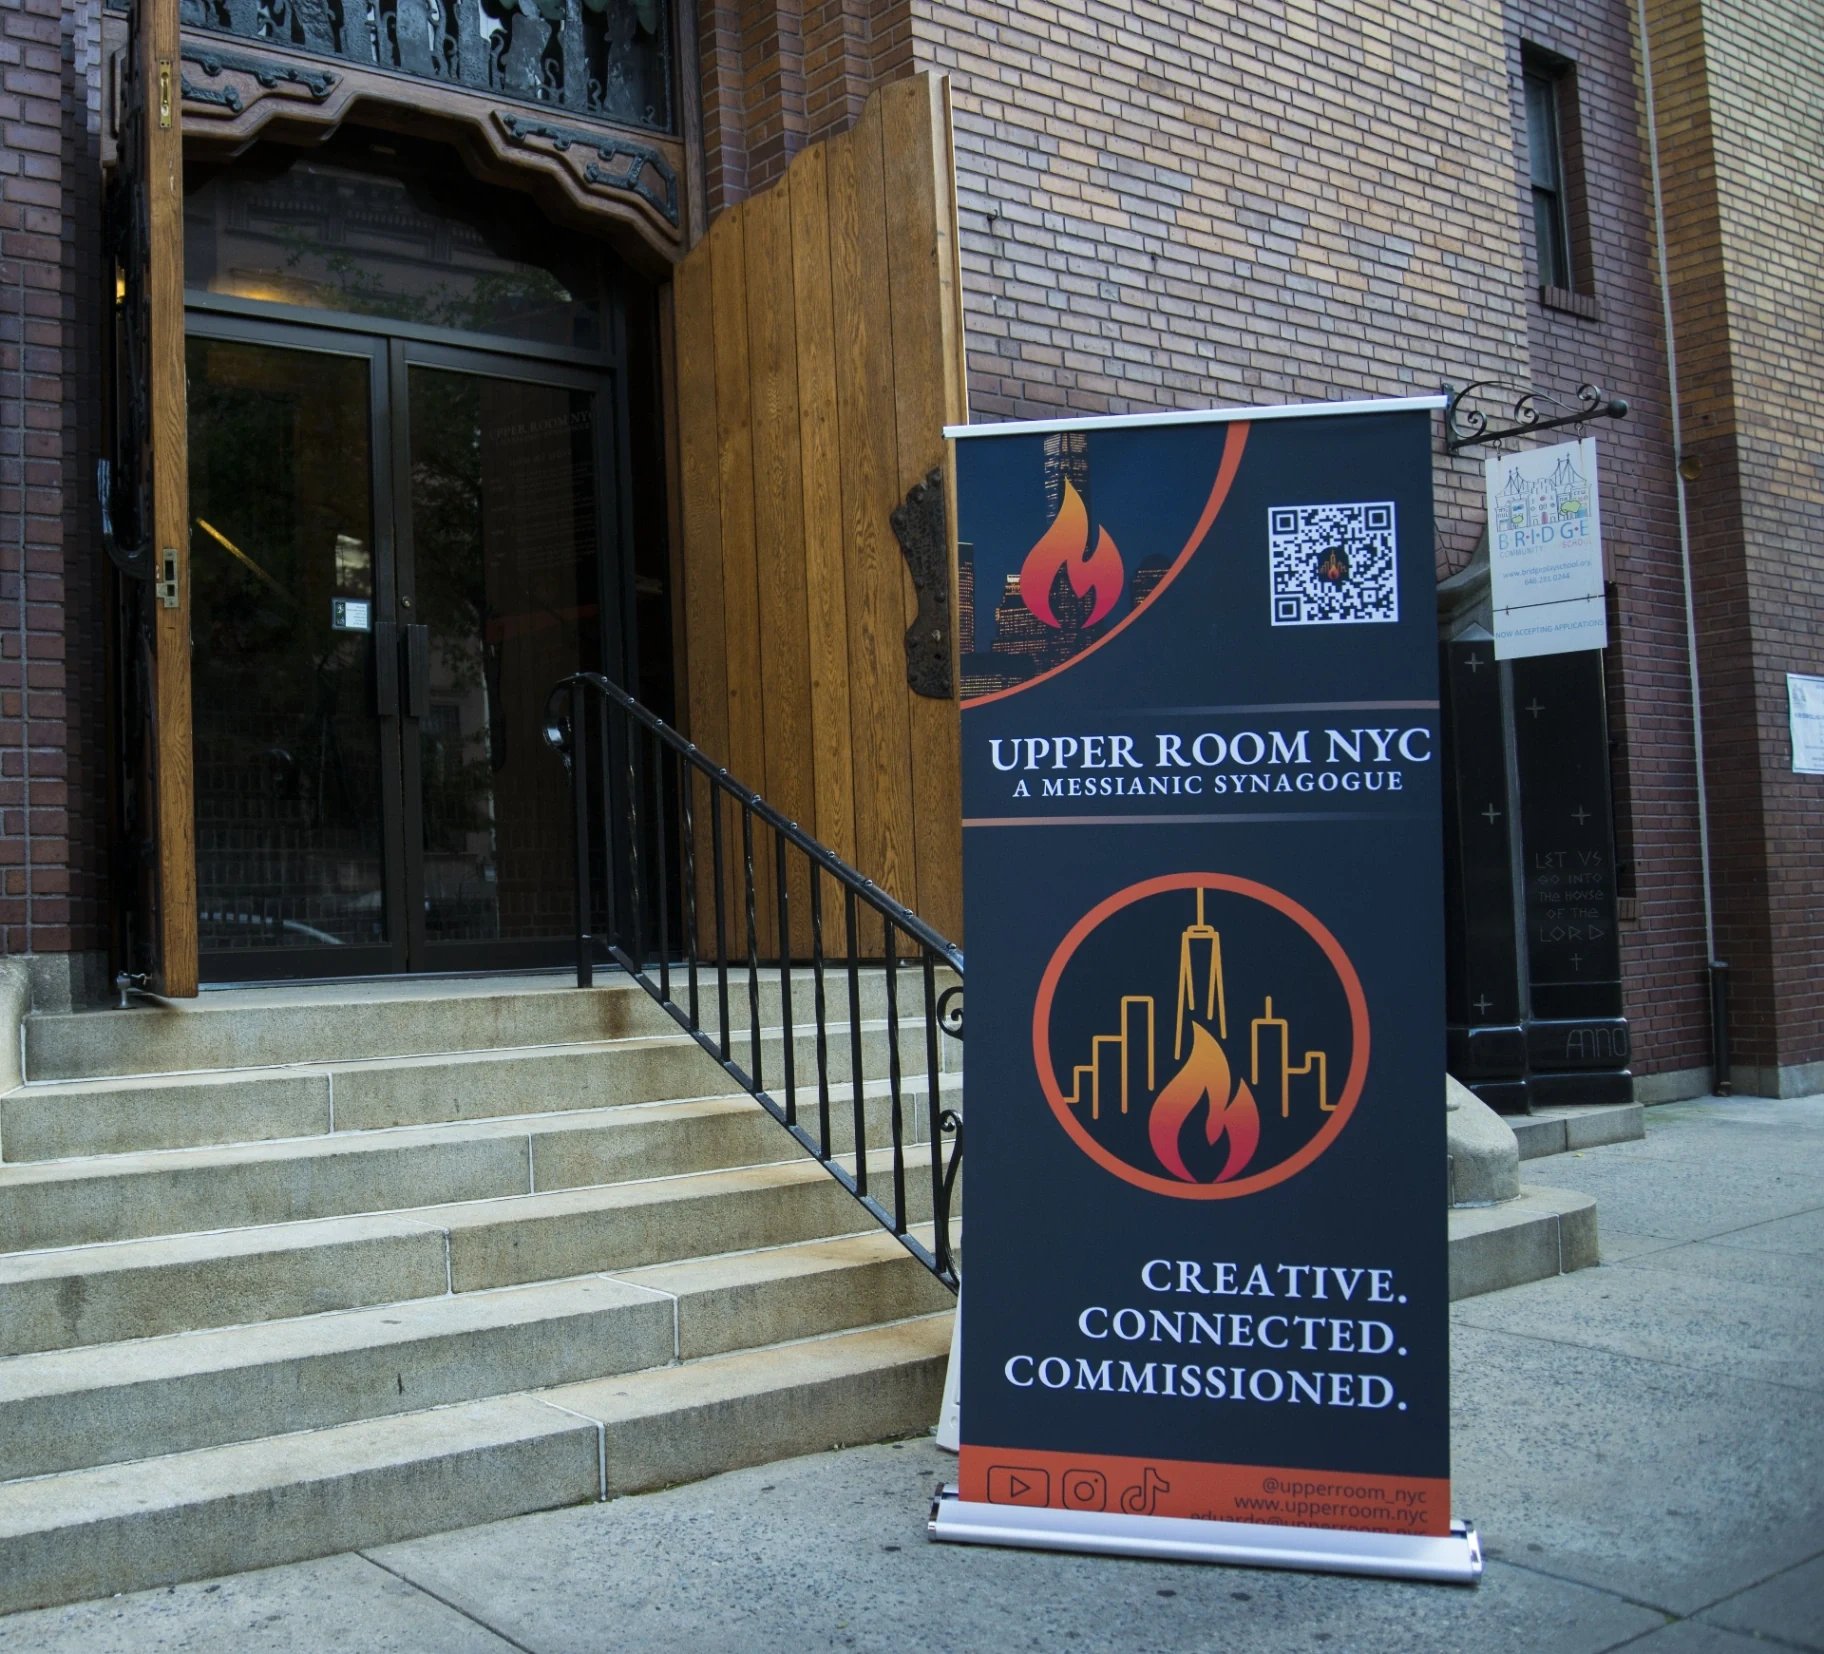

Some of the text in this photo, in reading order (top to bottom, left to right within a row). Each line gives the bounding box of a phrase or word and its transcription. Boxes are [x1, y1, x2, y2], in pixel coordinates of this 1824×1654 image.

[1496, 619, 1604, 639] NOW ACCEPTING APPLICATIONS
[989, 727, 1433, 771] UPPER ROOM NYC
[1012, 770, 1404, 798] A MESSIANIC SYNAGOGUE
[1536, 851, 1568, 869] LET
[1568, 873, 1603, 884] INTO
[1546, 908, 1565, 920] OF
[1540, 924, 1604, 942] LORD
[1141, 1258, 1408, 1304] CREATIVE.
[1078, 1306, 1408, 1356] CONNECTED.
[1004, 1354, 1408, 1411] COMMISSIONED.
[1263, 1477, 1427, 1505] @upperroom_nyc
[1234, 1496, 1428, 1526] www.upperroom.nyc
